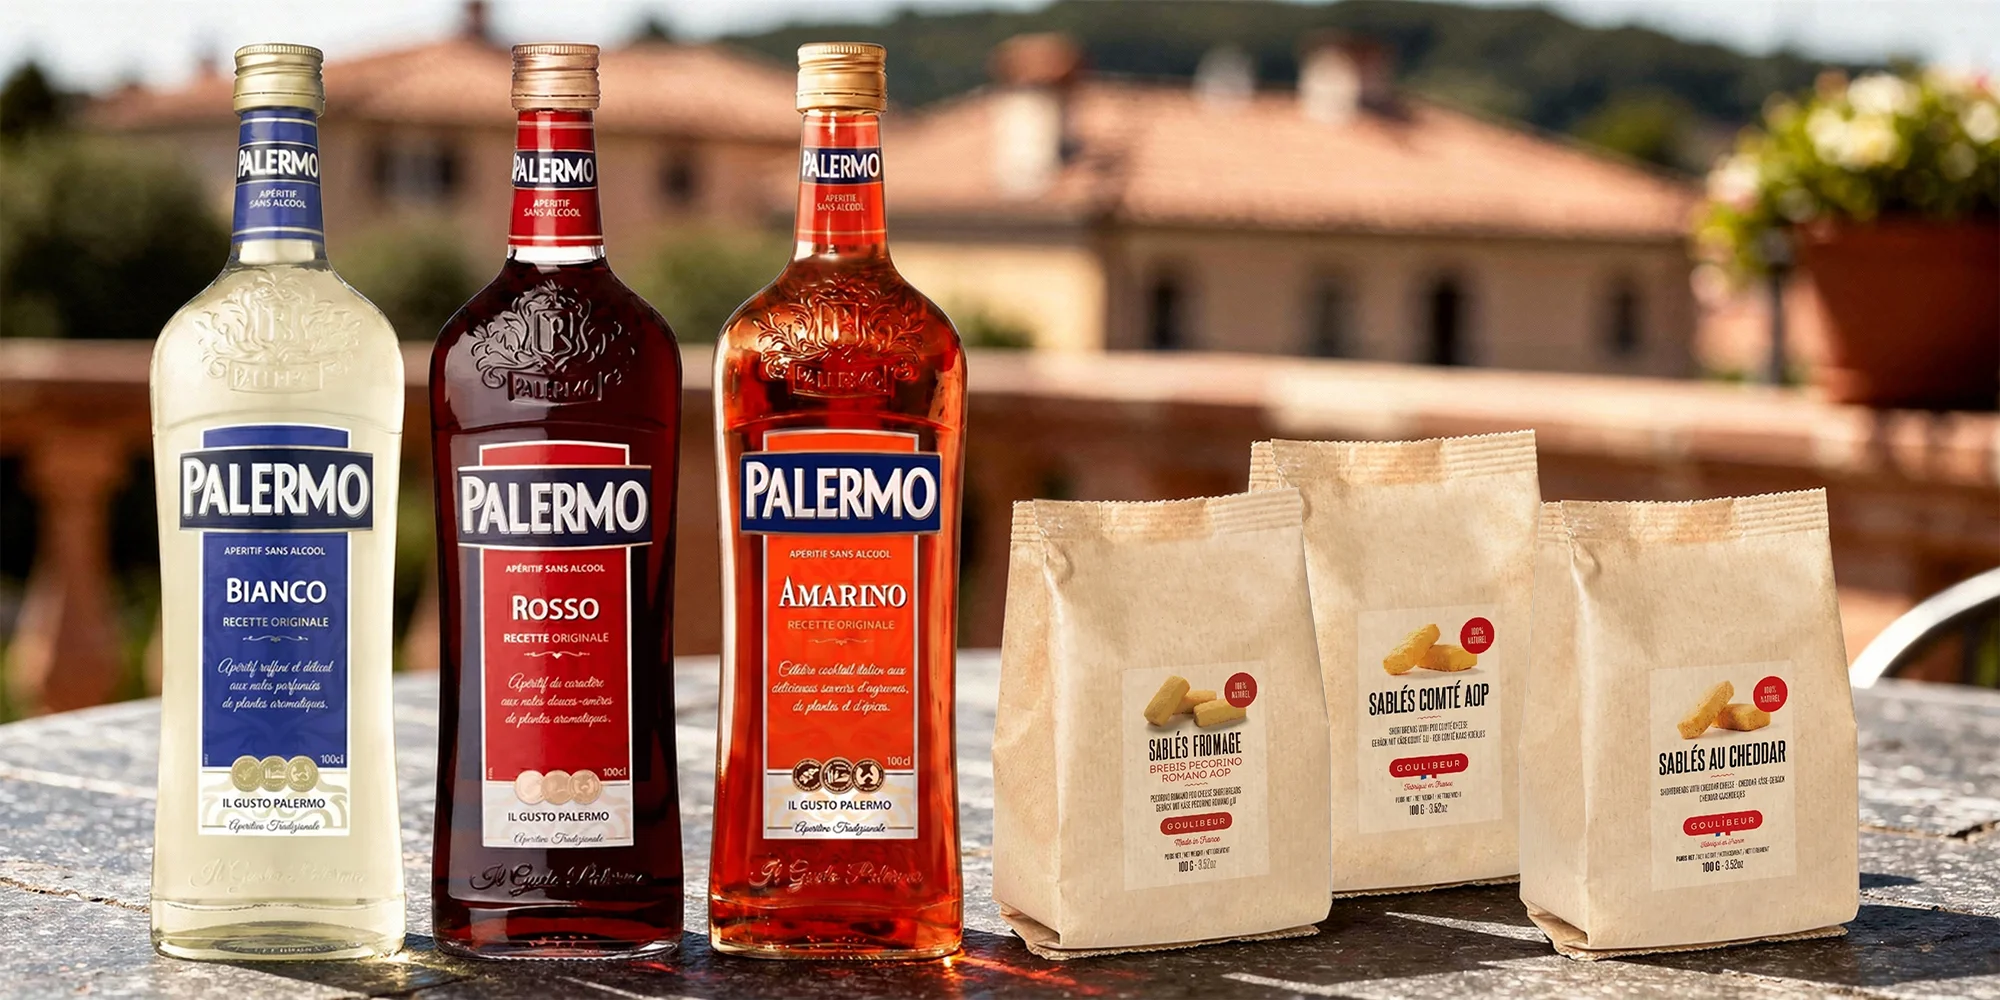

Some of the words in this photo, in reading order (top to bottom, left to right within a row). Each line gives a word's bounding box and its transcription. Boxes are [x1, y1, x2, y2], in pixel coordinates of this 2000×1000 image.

[237, 149, 319, 178] PALERMO
[512, 152, 595, 183] PALERMO
[802, 150, 880, 178] PALERMO
[250, 199, 271, 209] SANS
[273, 199, 306, 209] ALCOOL
[817, 203, 835, 211] SANS
[524, 208, 545, 217] SANS
[546, 208, 581, 217] ALCOOL
[183, 457, 370, 520] PALERMO
[746, 461, 937, 520] PALERMO
[461, 475, 648, 535] PALERMO
[265, 546, 288, 556] SANS
[290, 546, 325, 556] ALCOOL
[829, 549, 854, 558] SANS
[505, 563, 543, 573] APÉRITIF
[545, 564, 568, 573] SANS
[570, 564, 605, 573] ALCOOL
[226, 577, 327, 604] BIANCO
[778, 576, 908, 609] AMARINO
[512, 595, 600, 620] ROSSO
[223, 617, 268, 627] RECETTE
[271, 617, 329, 627] ORIGINALE
[788, 620, 835, 630] RECETTE
[837, 620, 895, 630] ORIGINALE
[504, 633, 549, 643] RECETTE
[551, 632, 609, 643] ORIGINALE
[887, 667, 907, 675] aux
[229, 682, 249, 691] aux
[222, 697, 233, 709] de
[233, 697, 268, 712] plantes
[501, 698, 518, 706] aux
[520, 695, 545, 706] notes
[1369, 684, 1416, 716] SABLÉS
[1419, 680, 1461, 711] COMTÉ
[1464, 683, 1489, 708] AOP
[792, 699, 803, 712] de
[804, 699, 839, 715] plantes
[505, 712, 517, 724] de
[517, 712, 551, 728] plantes
[1149, 730, 1188, 761] SABLÉS
[1193, 731, 1242, 757] FROMAGE
[320, 754, 344, 764] 100cl
[887, 756, 911, 766] 100cl
[1659, 744, 1706, 776] SABLÉS
[1708, 746, 1726, 771] AU
[1729, 740, 1786, 768] CHEDDAR
[603, 767, 626, 777] 100cl
[1149, 761, 1187, 774] BREBIS
[1188, 757, 1242, 772] PECORINO
[1397, 760, 1460, 772] GOULIBEUR
[1162, 770, 1207, 783] ROMANO
[1209, 767, 1231, 778] AOP
[222, 798, 232, 808] IL
[234, 798, 271, 809] GUSTO
[274, 798, 326, 809] PALERMO
[788, 800, 797, 810] IL
[800, 800, 838, 810] GUSTO
[840, 800, 892, 811] PALERMO
[1409, 804, 1419, 815] 100
[1420, 803, 1425, 815] G
[1429, 802, 1448, 814] 3.52oz
[508, 812, 517, 821] IL
[519, 812, 556, 822] GUSTO
[558, 811, 610, 821] PALERMO
[266, 819, 320, 834] Tradizionale
[1167, 817, 1226, 830] GOULIBEUR
[1178, 861, 1188, 873] 100
[1189, 860, 1194, 871] G
[1198, 858, 1217, 871] 3.52oz
[1702, 861, 1714, 873] 100
[1715, 861, 1720, 871] G
[1725, 859, 1744, 870] 3.52oz
